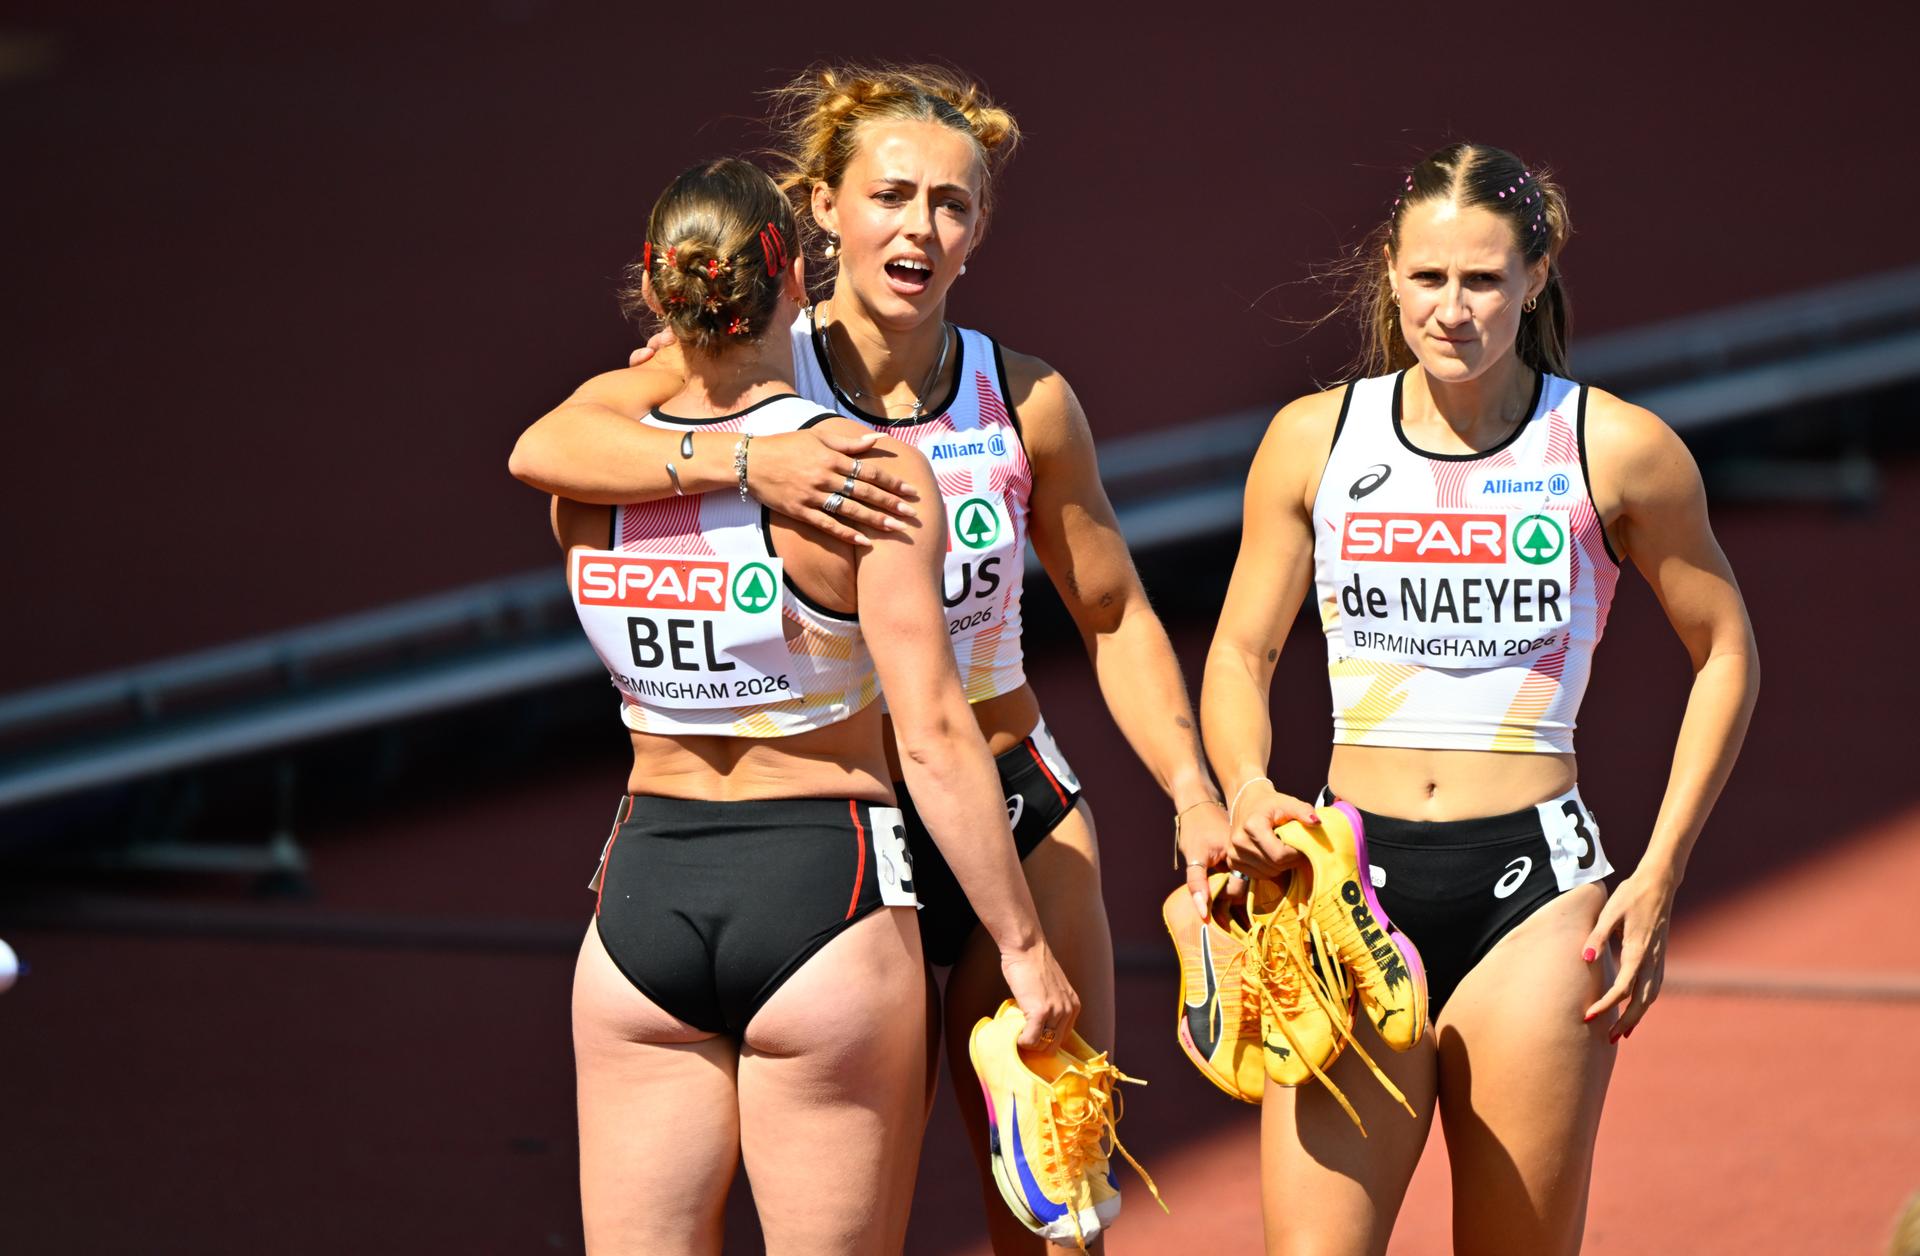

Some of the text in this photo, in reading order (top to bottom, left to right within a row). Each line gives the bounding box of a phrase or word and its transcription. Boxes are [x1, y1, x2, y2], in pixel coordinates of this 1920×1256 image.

[931, 442, 986, 460] Allianz
[1482, 479, 1544, 495] Allianz
[1346, 518, 1502, 557] SPAR
[582, 562, 724, 605] SPAR
[941, 556, 1001, 609] US
[1341, 573, 1563, 624] de NAEYER
[950, 606, 993, 636] 2026
[626, 616, 736, 672] BEL
[1353, 630, 1556, 657] BIRMINGHAM 2026
[734, 674, 790, 698] 2026
[1560, 799, 1596, 870] 3
[892, 824, 916, 894] 3
[1341, 880, 1410, 1001] NITRO
